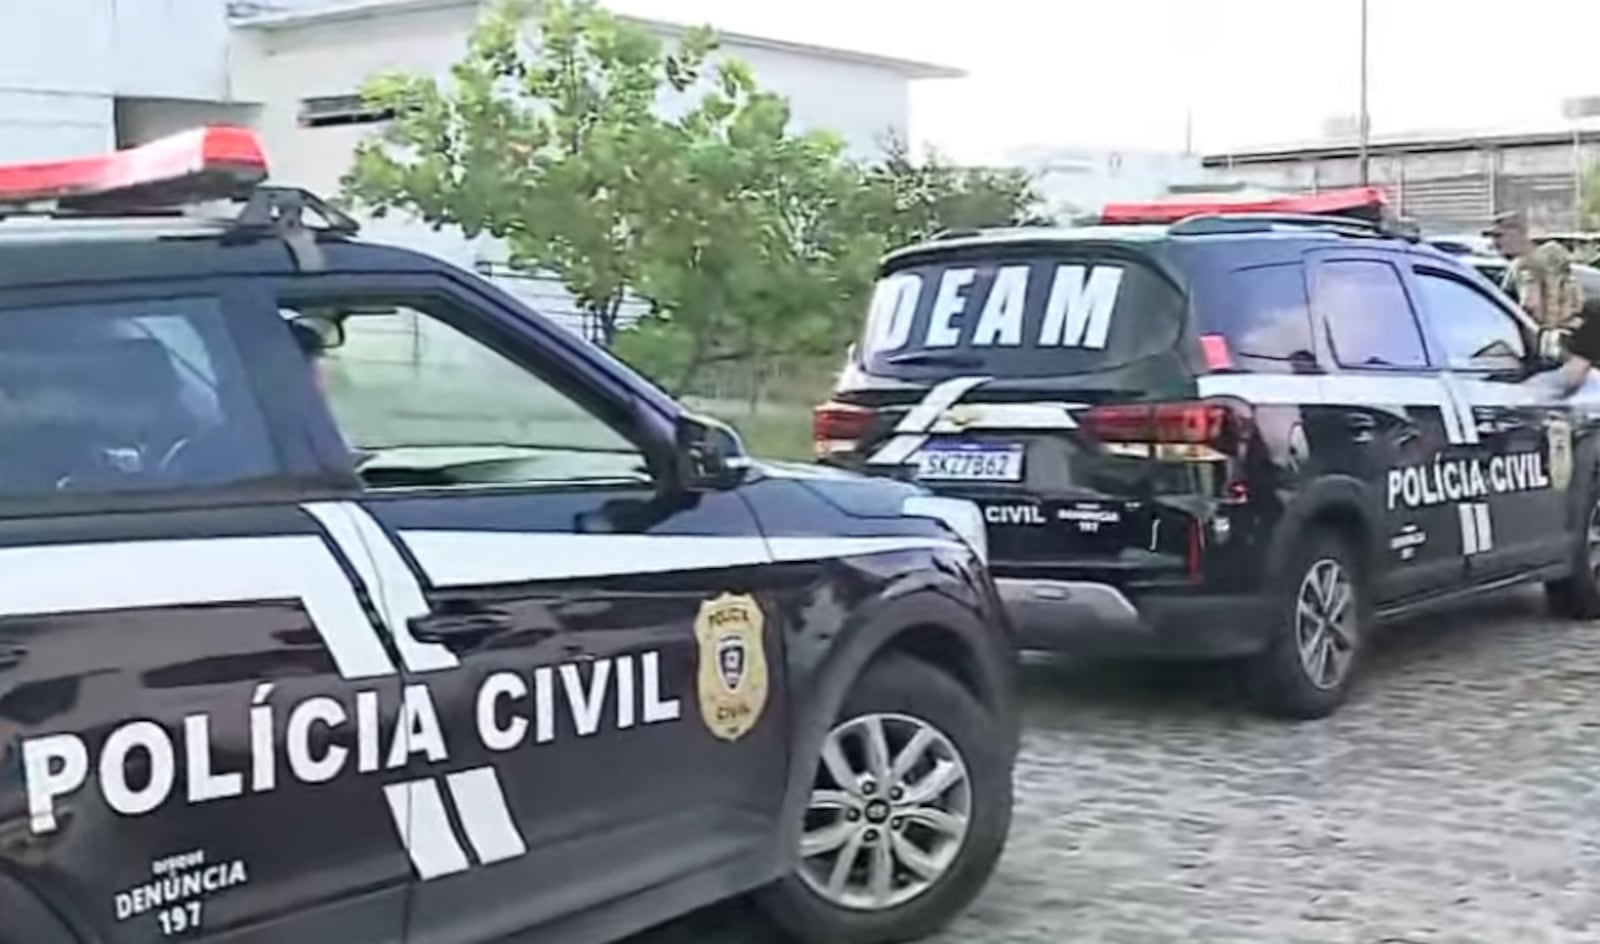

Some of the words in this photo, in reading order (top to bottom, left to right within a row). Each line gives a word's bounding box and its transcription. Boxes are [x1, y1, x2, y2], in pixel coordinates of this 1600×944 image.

[864, 265, 1124, 349] DEAM
[1388, 452, 1487, 509] POLÍCIA
[1490, 452, 1548, 492] CIVIL
[985, 505, 1046, 524] CIVIL
[22, 682, 449, 834] POLÍCIA
[476, 651, 680, 752] CIVIL
[114, 860, 247, 920] DENÚNCIA
[157, 901, 202, 935] 197
